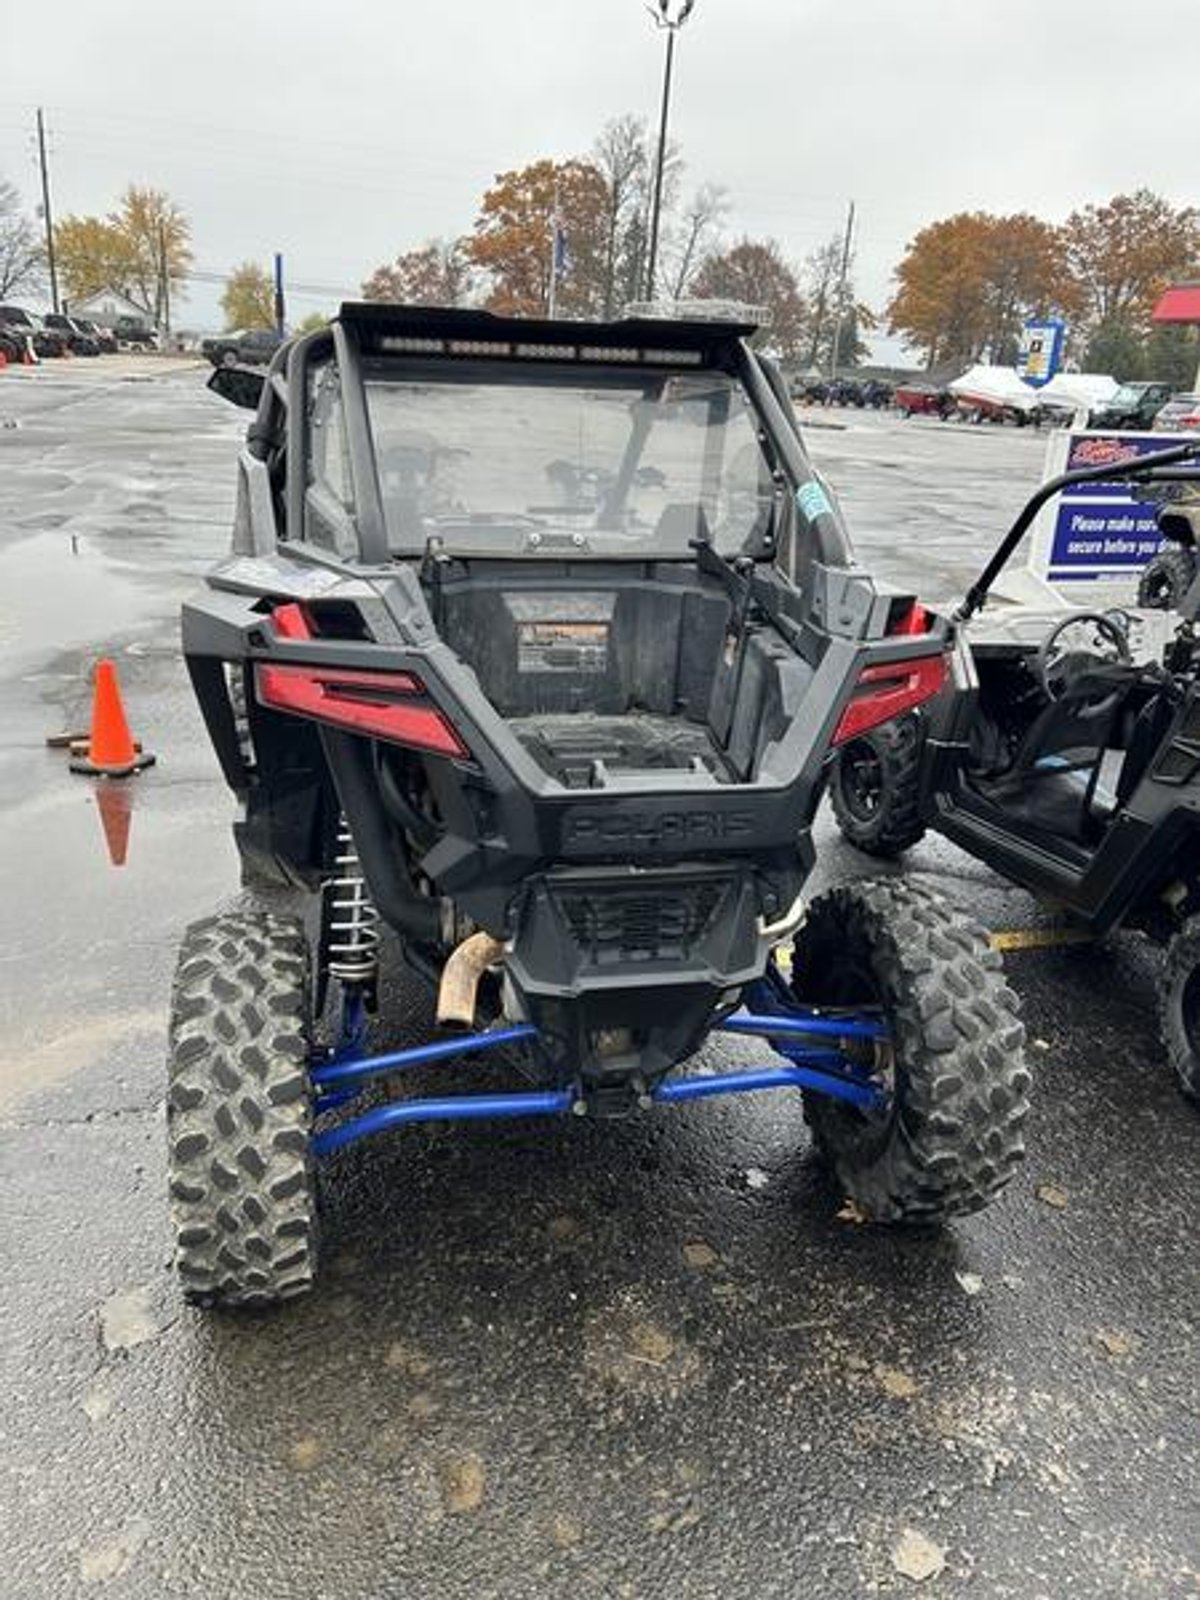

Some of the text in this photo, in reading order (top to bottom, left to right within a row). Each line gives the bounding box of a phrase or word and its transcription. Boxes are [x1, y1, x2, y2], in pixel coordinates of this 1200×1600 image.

[1071, 515, 1105, 532] Please
[1106, 515, 1135, 532] make
[1067, 541, 1103, 554] secure
[1104, 538, 1136, 554] before
[1135, 541, 1157, 557] you
[566, 810, 755, 842] POLARIS
